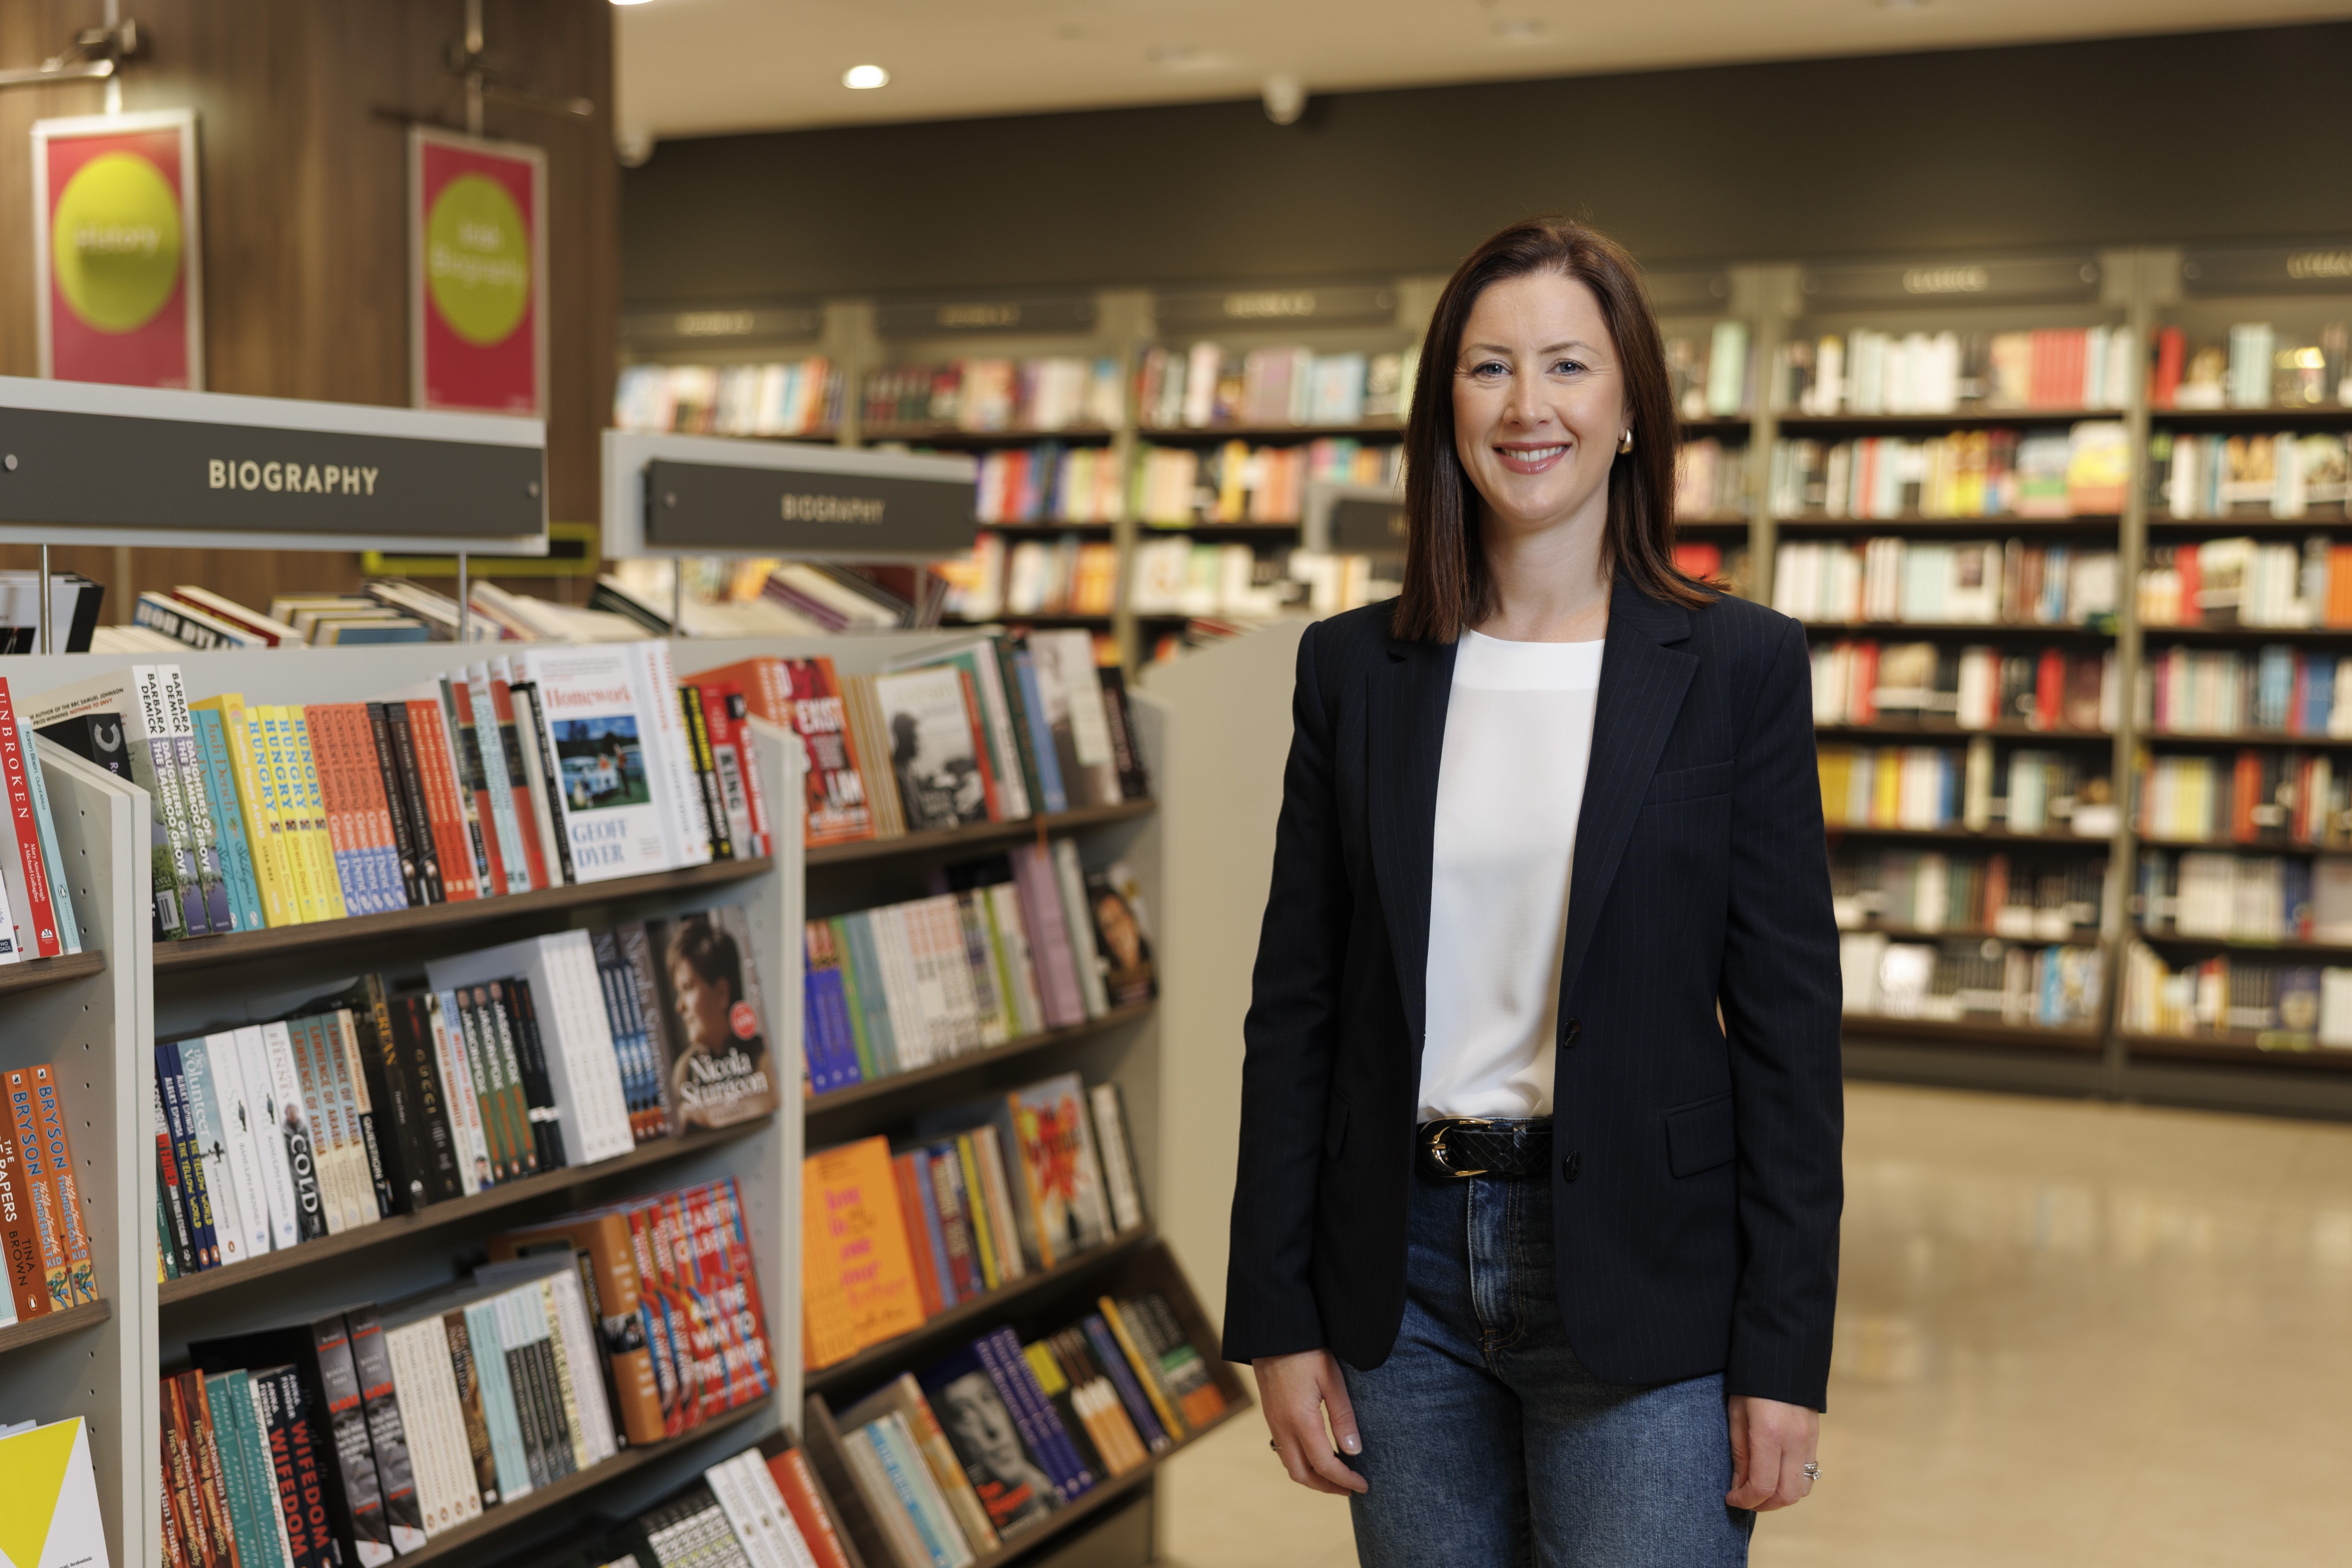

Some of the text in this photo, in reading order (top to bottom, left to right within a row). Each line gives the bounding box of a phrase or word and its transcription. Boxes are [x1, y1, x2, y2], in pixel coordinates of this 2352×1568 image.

[209, 459, 378, 496] BIOGRAPHY
[782, 494, 886, 525] BIOGRAPHY
[35, 708, 53, 718] AUTHOR
[81, 695, 99, 705] SAMUEL
[100, 688, 123, 699] JOHNSON
[70, 705, 92, 715] NOTHING
[100, 697, 113, 707] ENVY
[142, 686, 158, 734] DEMICK
[148, 673, 165, 733] BARBARA
[166, 686, 182, 733] DEMICK
[172, 673, 189, 732] BARBARA
[161, 741, 188, 838] DAUGHTERS OF
[185, 740, 212, 835] DAUGHTERS OF
[207, 721, 223, 754] Judi
[216, 759, 235, 812] Dench
[248, 721, 277, 812] HUNGRY
[265, 720, 293, 810] HUNGRY
[279, 720, 307, 810] HUNGRY
[295, 719, 323, 808] HUNGRY
[720, 755, 742, 809] KING
[153, 741, 187, 875] THE BAMBOO GROVE
[178, 740, 212, 873] THE BAMBOO GROVE
[252, 802, 265, 838] ADHD
[25, 849, 34, 873] Michael
[30, 874, 39, 902] Gallagher
[34, 860, 45, 901] Attenborough
[374, 1002, 397, 1066] CREAN
[459, 1009, 479, 1059] JASON
[471, 1062, 486, 1095] FOX
[476, 1005, 495, 1055] JASON
[488, 1057, 503, 1091] FOX
[493, 1000, 520, 1085] JASON FOX
[689, 1047, 752, 1083] Nicola
[291, 1031, 327, 1157] LAWRENCE ARABIA
[309, 1025, 344, 1152] LAWRENCE ARABIA
[680, 1072, 768, 1111] Sturgeon
[4, 1140, 15, 1163] THE
[12, 1091, 43, 1176] BRYSON
[38, 1085, 68, 1169] BRYSON
[363, 1115, 385, 1190] QUESTION 7
[0, 1159, 17, 1222] PAPERS
[181, 1159, 195, 1194] YELLOW
[189, 1196, 201, 1228] WORLD
[192, 1156, 206, 1191] YELLOW
[200, 1194, 212, 1225] WORLD
[289, 1133, 319, 1214] COLD
[31, 1181, 53, 1257] THUNDERBOLT
[57, 1174, 78, 1249] THUNDERBOLT
[9, 1230, 27, 1286] BROWN
[22, 1238, 35, 1272] TINA
[46, 1257, 62, 1268] KID
[72, 1249, 87, 1260] KID
[252, 1397, 266, 1441] Dawn
[259, 1383, 274, 1427] FUNDER
[266, 1381, 279, 1414] ANNA
[280, 1376, 296, 1420] FUNDER
[288, 1374, 301, 1406] ANNA
[168, 1429, 177, 1455] Fires
[173, 1454, 185, 1488] Which
[194, 1420, 203, 1445] Fires
[199, 1445, 211, 1479] Which
[181, 1439, 207, 1553] Sebastian Faulks
[207, 1430, 234, 1542] Sebastian Faulks
[270, 1427, 308, 1559] WIFEDOM
[291, 1419, 330, 1549] WIFEDOM
